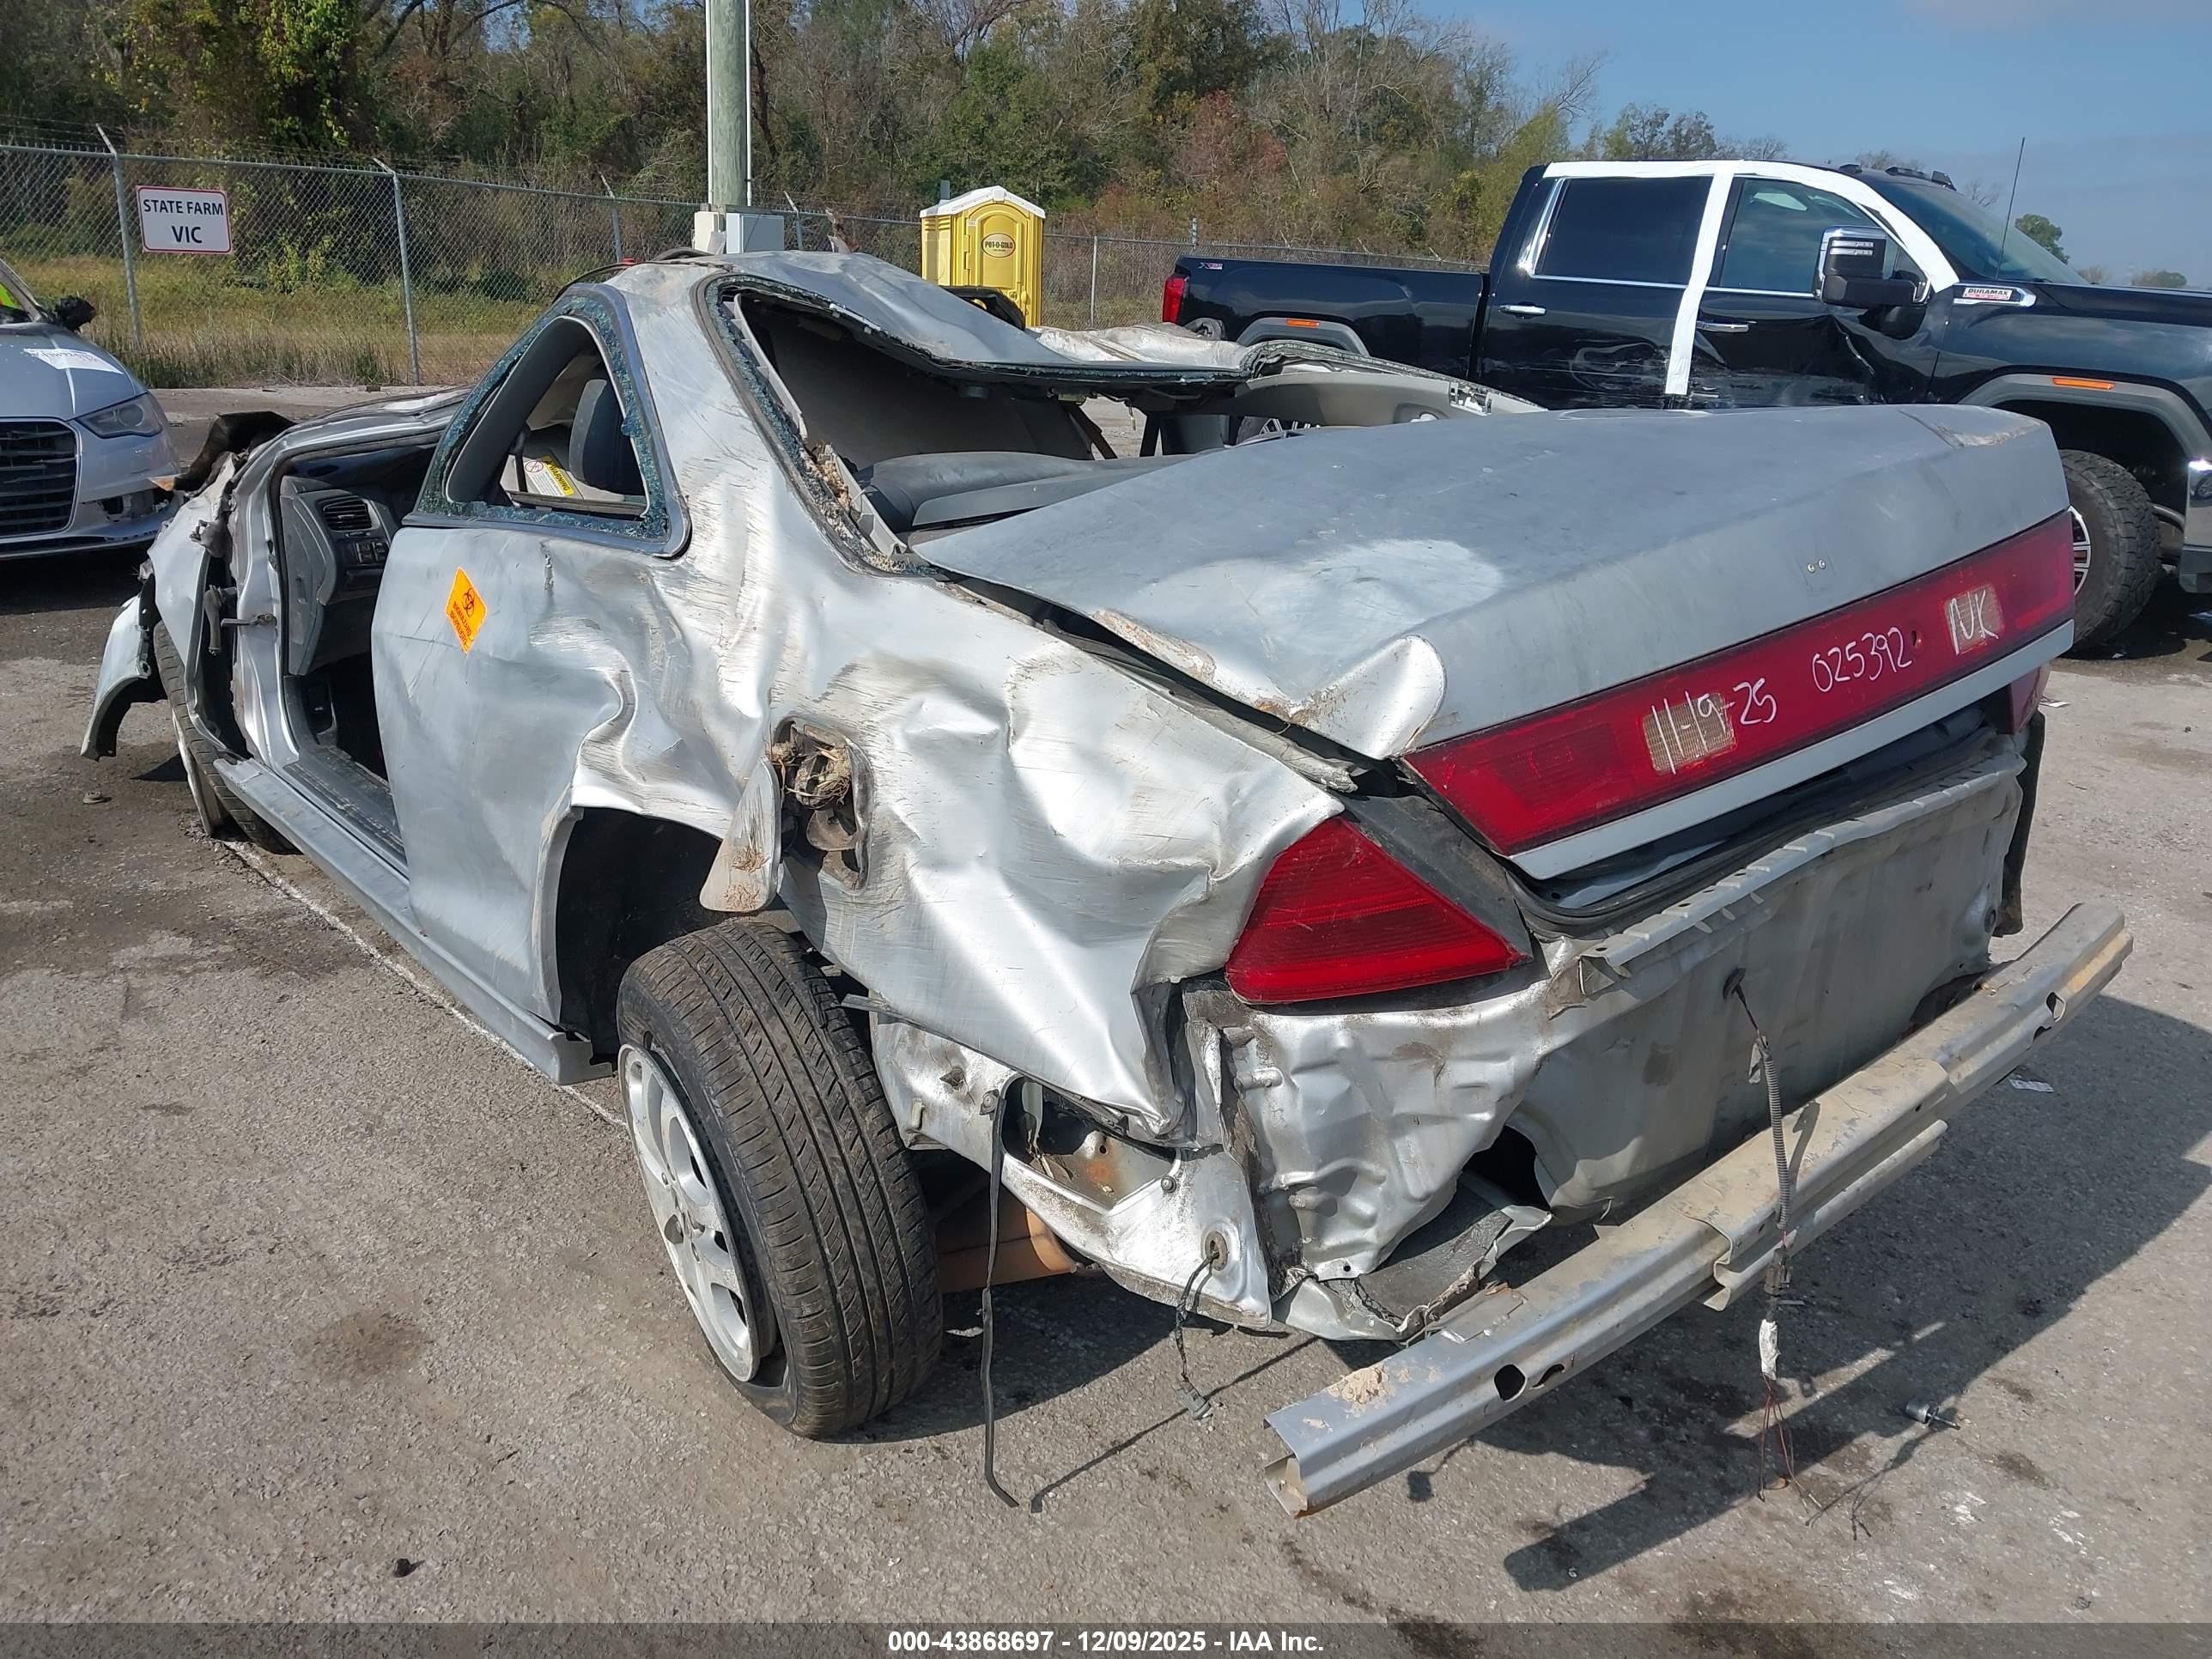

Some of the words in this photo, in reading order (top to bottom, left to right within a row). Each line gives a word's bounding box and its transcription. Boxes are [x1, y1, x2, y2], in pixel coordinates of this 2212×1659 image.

[143, 198, 184, 214] STATE
[186, 201, 224, 216] FARM
[171, 225, 203, 244] VIC
[984, 240, 1013, 249] POT-O-GOLD
[1967, 288, 2008, 296] DURAMAX
[550, 465, 571, 491] WARNING
[1812, 626, 1913, 693] 025392
